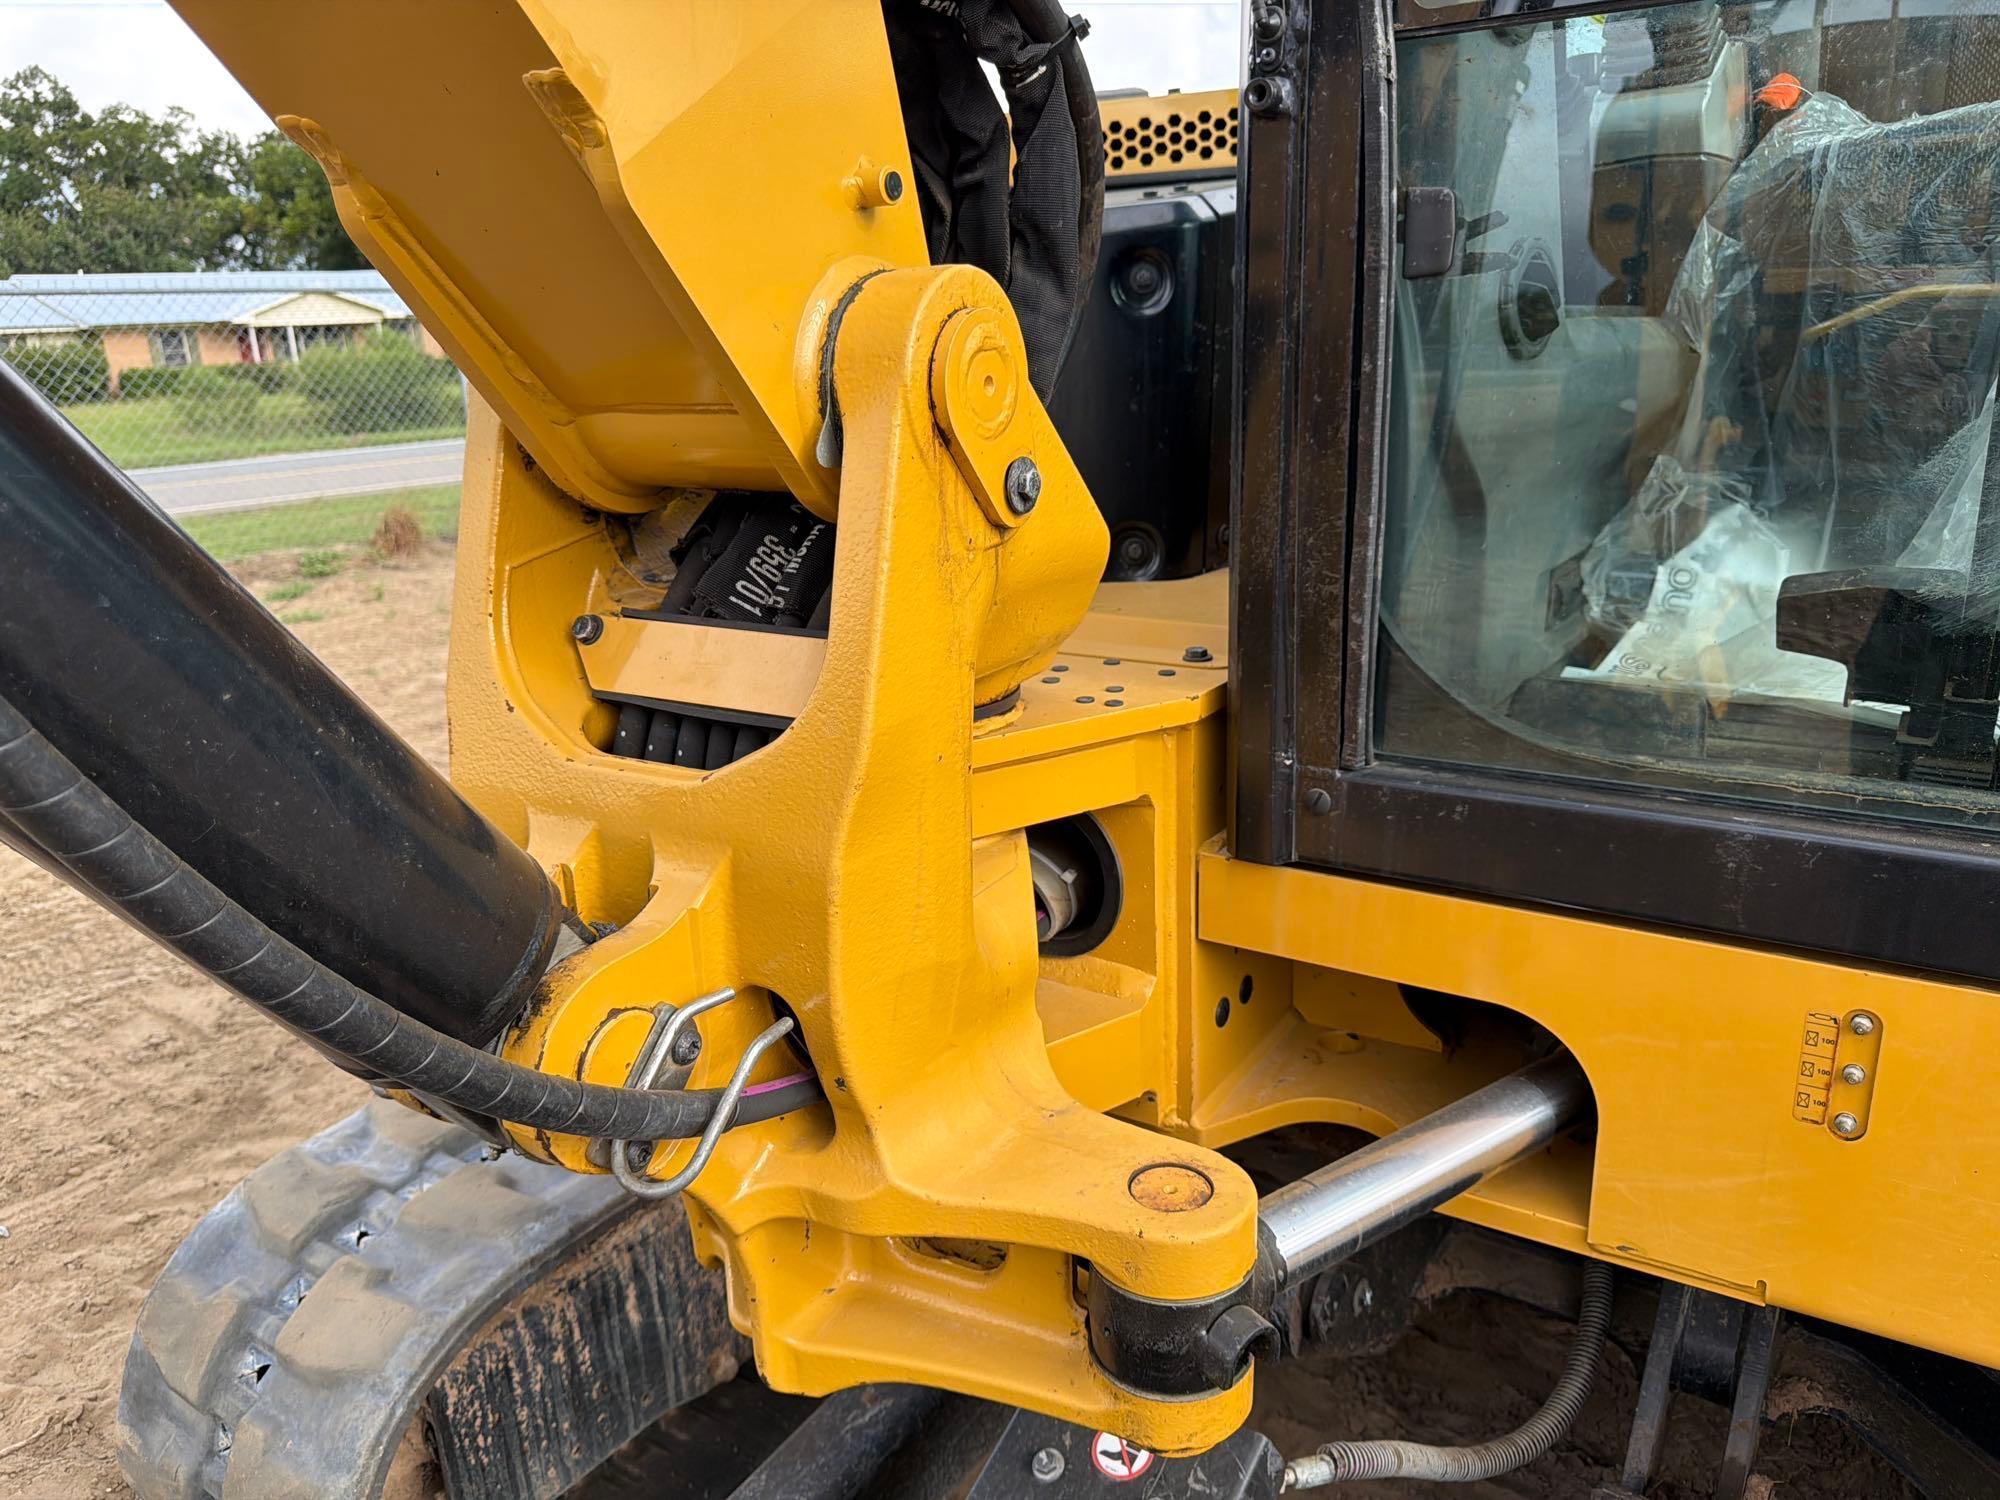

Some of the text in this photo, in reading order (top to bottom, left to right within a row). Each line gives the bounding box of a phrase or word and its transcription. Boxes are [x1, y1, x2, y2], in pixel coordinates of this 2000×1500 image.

[1821, 1037, 1835, 1046] 100
[1817, 1068, 1831, 1077] 100
[1813, 1099, 1827, 1108] 100
